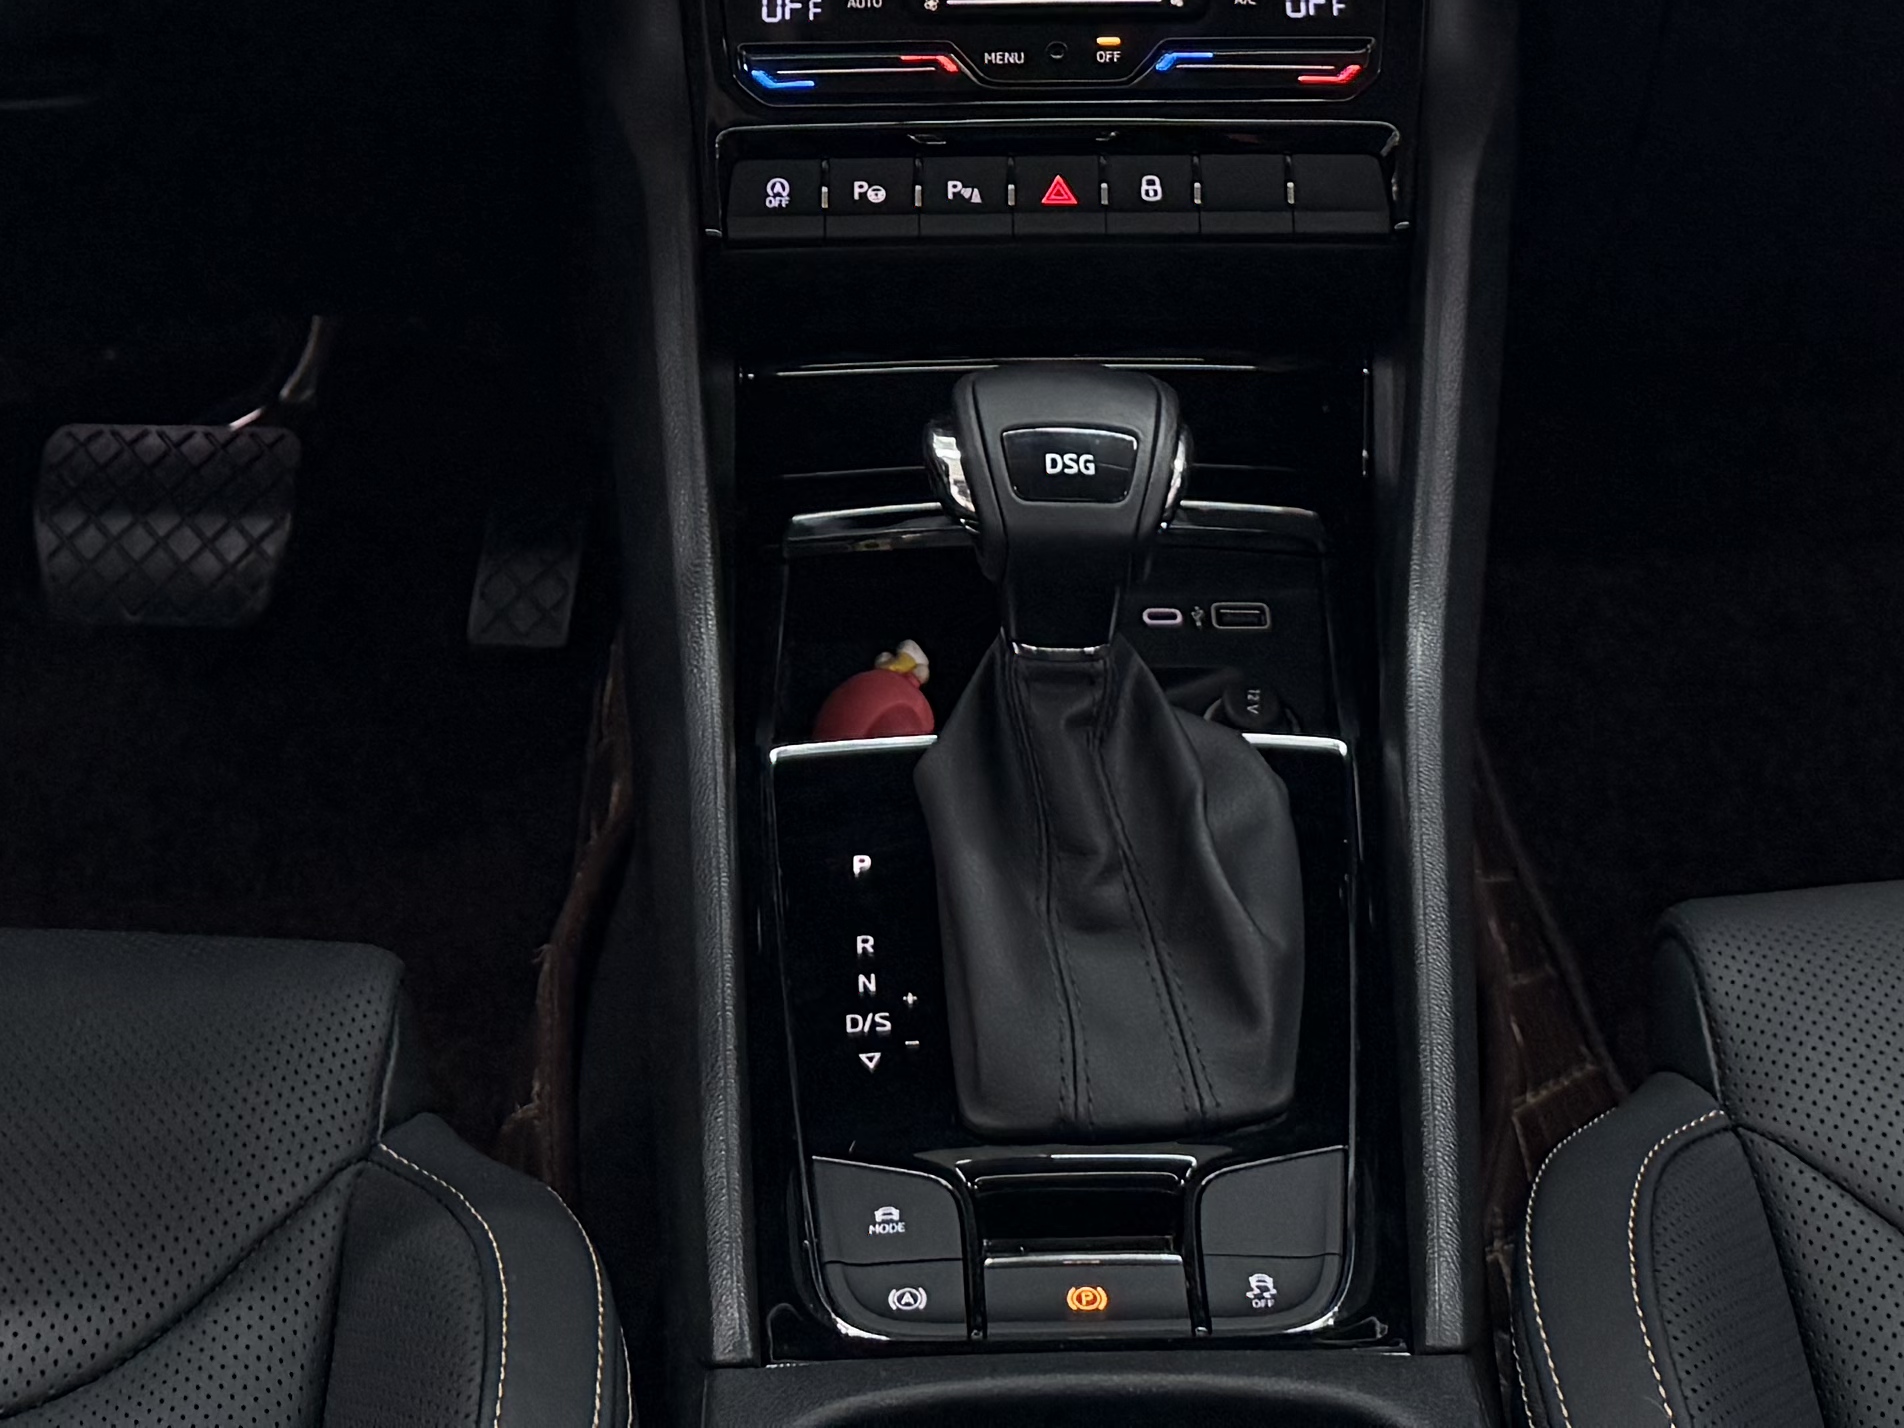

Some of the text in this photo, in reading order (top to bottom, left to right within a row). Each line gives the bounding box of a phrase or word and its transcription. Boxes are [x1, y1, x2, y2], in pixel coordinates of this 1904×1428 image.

[985, 52, 1024, 64] MENU
[1097, 51, 1120, 62] OFF
[765, 197, 790, 208] OFF
[1046, 453, 1095, 475] DSG
[853, 855, 871, 876] P
[857, 935, 874, 954] R
[858, 974, 876, 992] N
[846, 1013, 891, 1033] D/S
[868, 1222, 906, 1234] MODE
[1252, 1298, 1275, 1308] OFF
